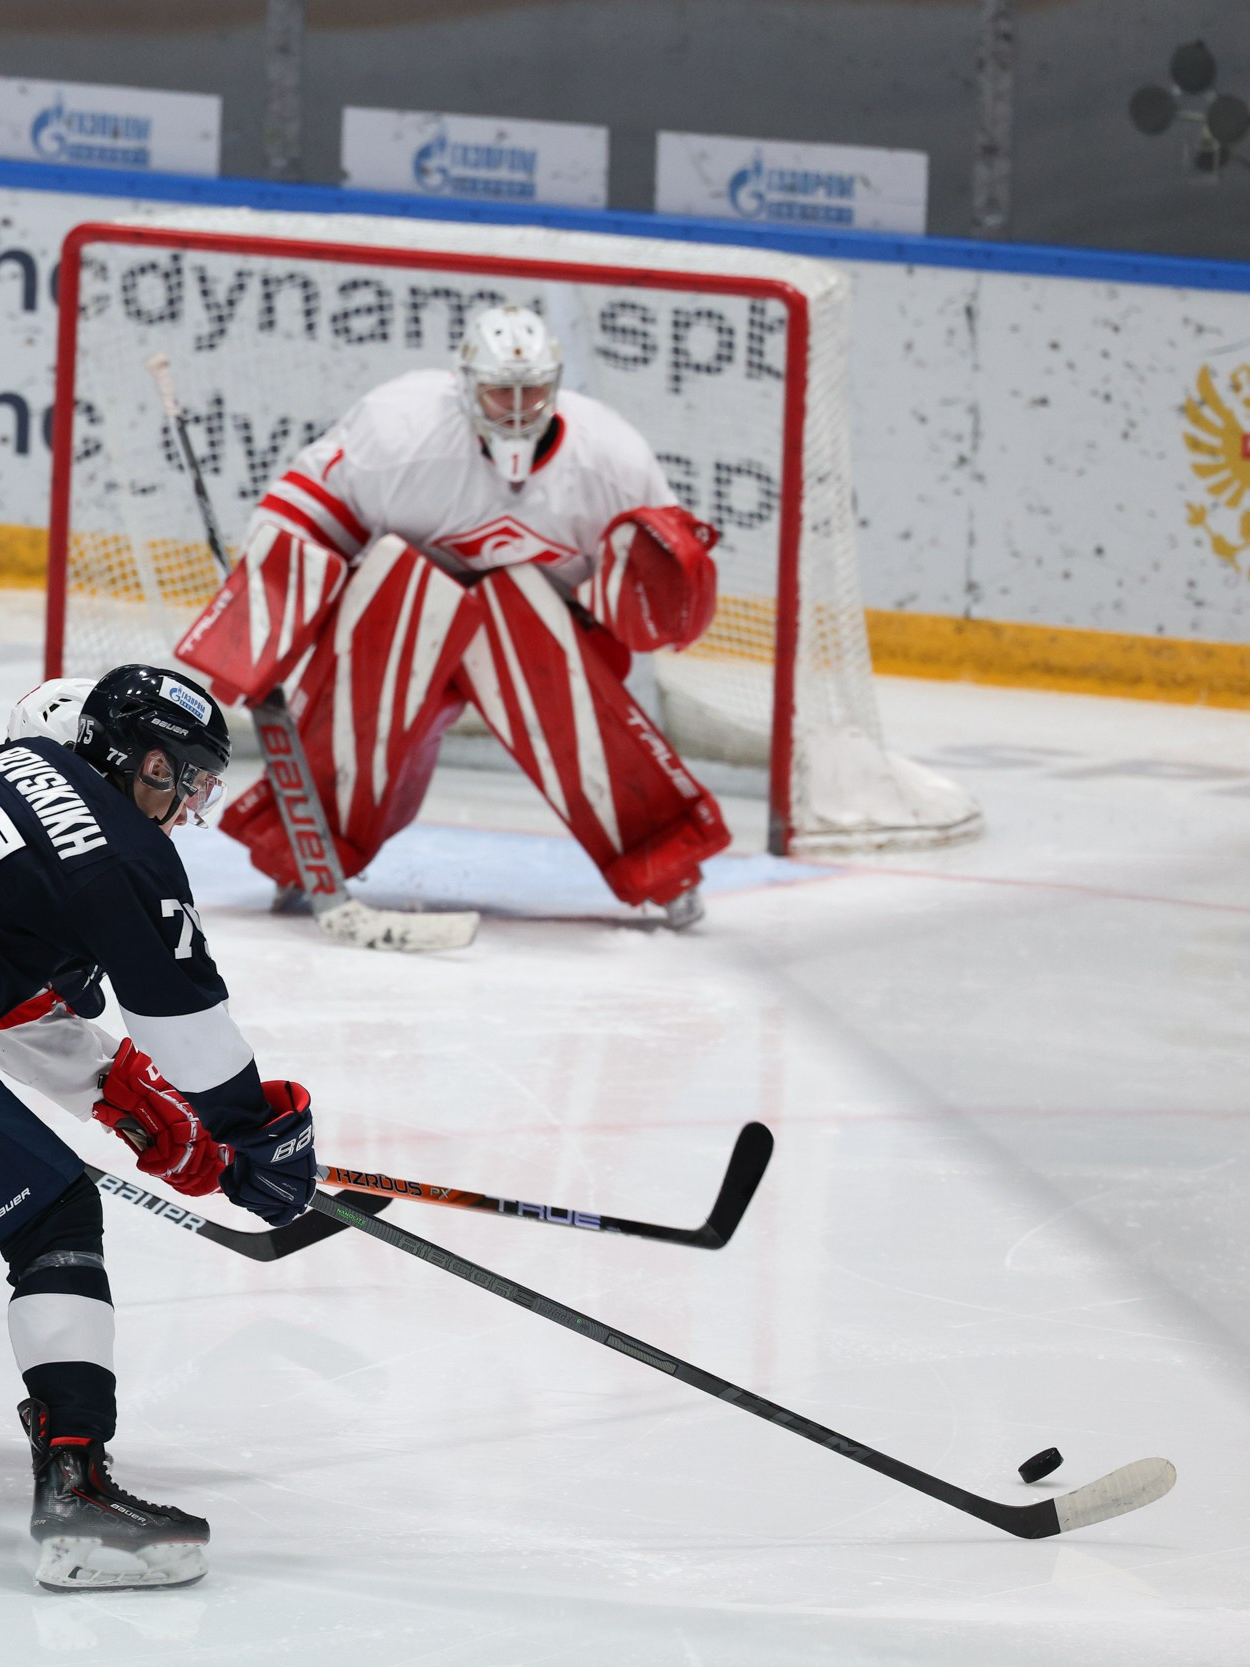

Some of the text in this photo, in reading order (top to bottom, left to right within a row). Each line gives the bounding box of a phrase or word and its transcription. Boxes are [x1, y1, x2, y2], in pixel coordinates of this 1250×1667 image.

[77, 718, 95, 745] 75
[106, 747, 129, 766] 77
[261, 725, 337, 895] BAUER
[336, 1167, 422, 1197] HZRDUS
[110, 1503, 149, 1527] BAUER
